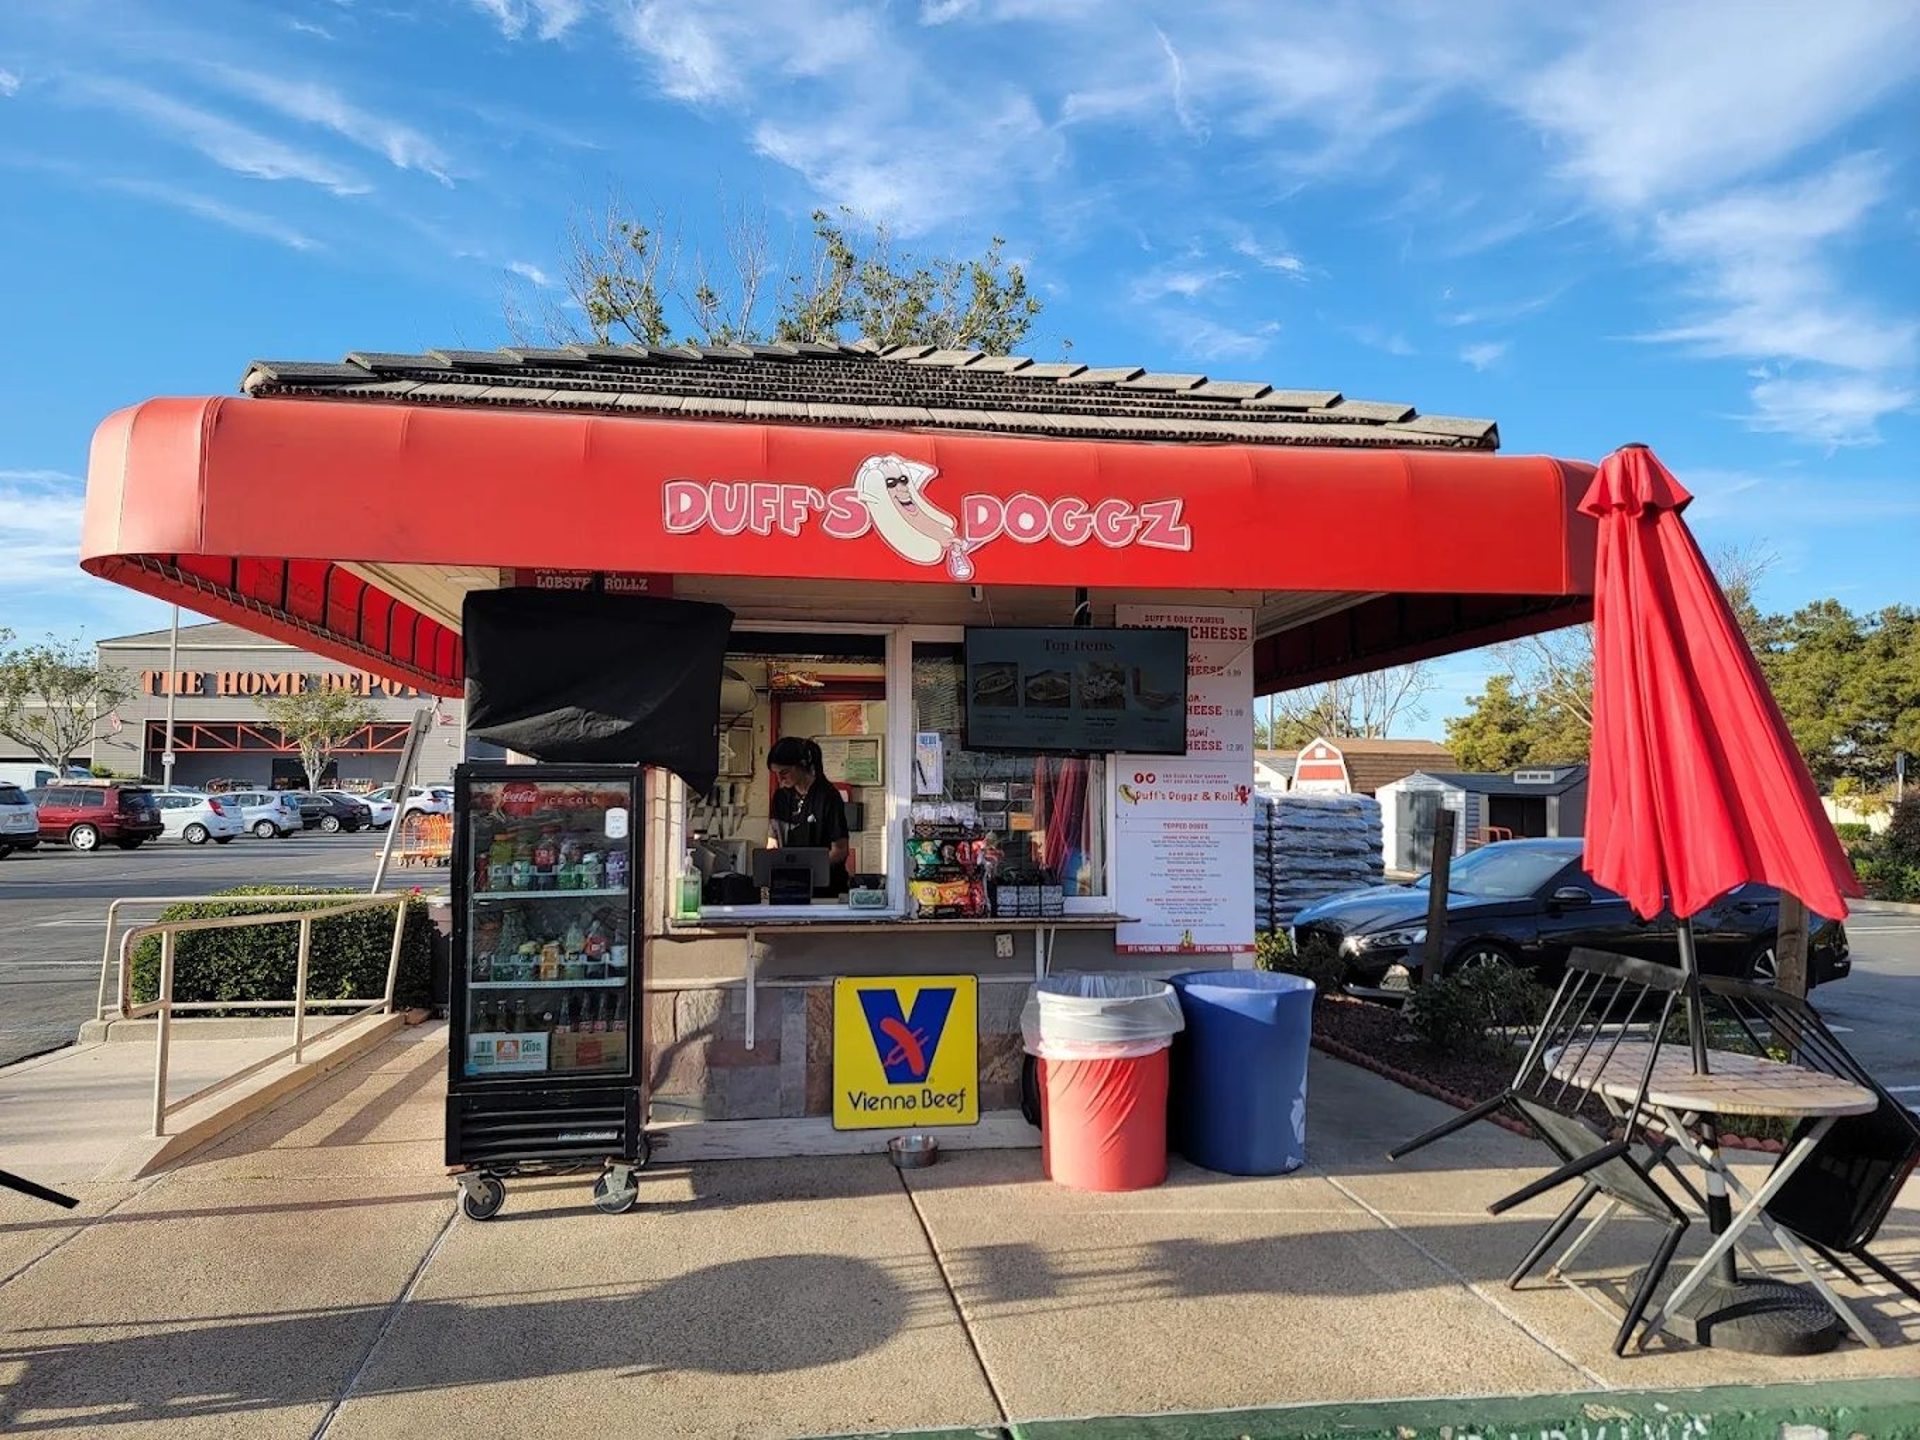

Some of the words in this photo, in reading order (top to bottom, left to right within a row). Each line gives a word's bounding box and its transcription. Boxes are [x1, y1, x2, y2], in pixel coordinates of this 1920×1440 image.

[662, 479, 873, 539] DUFF'S
[963, 493, 1191, 551] DOGGZ
[604, 577, 648, 591] ROLLZ
[1190, 626, 1248, 640] CHEESE
[1043, 639, 1070, 654] Top
[1074, 639, 1115, 652] Items
[1187, 665, 1223, 677] HEESE
[140, 671, 204, 696] THE
[215, 671, 308, 696] HOME
[1187, 705, 1222, 716] HEESE
[1187, 740, 1222, 751] HEESE
[1202, 791, 1211, 801] &
[848, 1090, 917, 1111] Vienna
[921, 1088, 967, 1114] Beef
